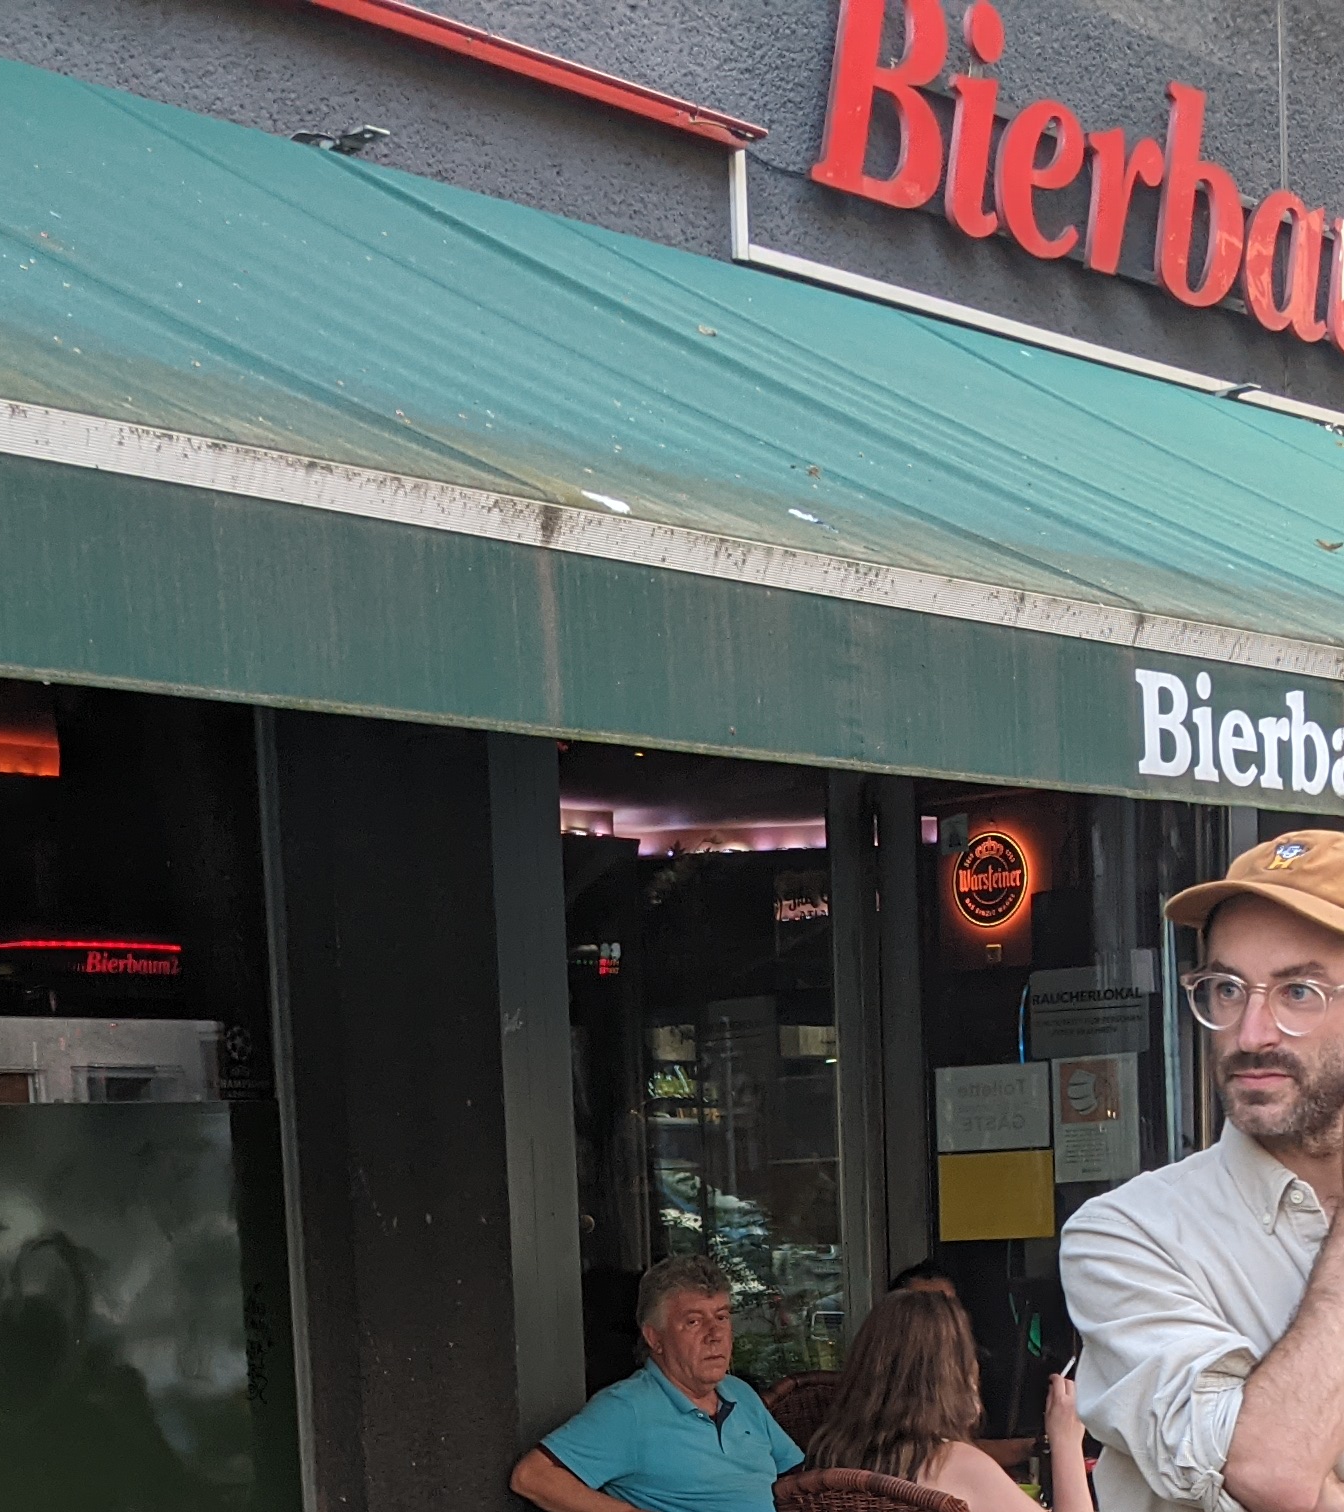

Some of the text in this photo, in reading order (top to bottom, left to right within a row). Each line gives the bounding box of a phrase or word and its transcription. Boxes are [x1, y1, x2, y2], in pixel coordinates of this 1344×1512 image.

[958, 863, 1022, 893] Warsteiner
[85, 950, 171, 976] Bierbaum
[1032, 986, 1143, 1006] RAUCHERLOKAL
